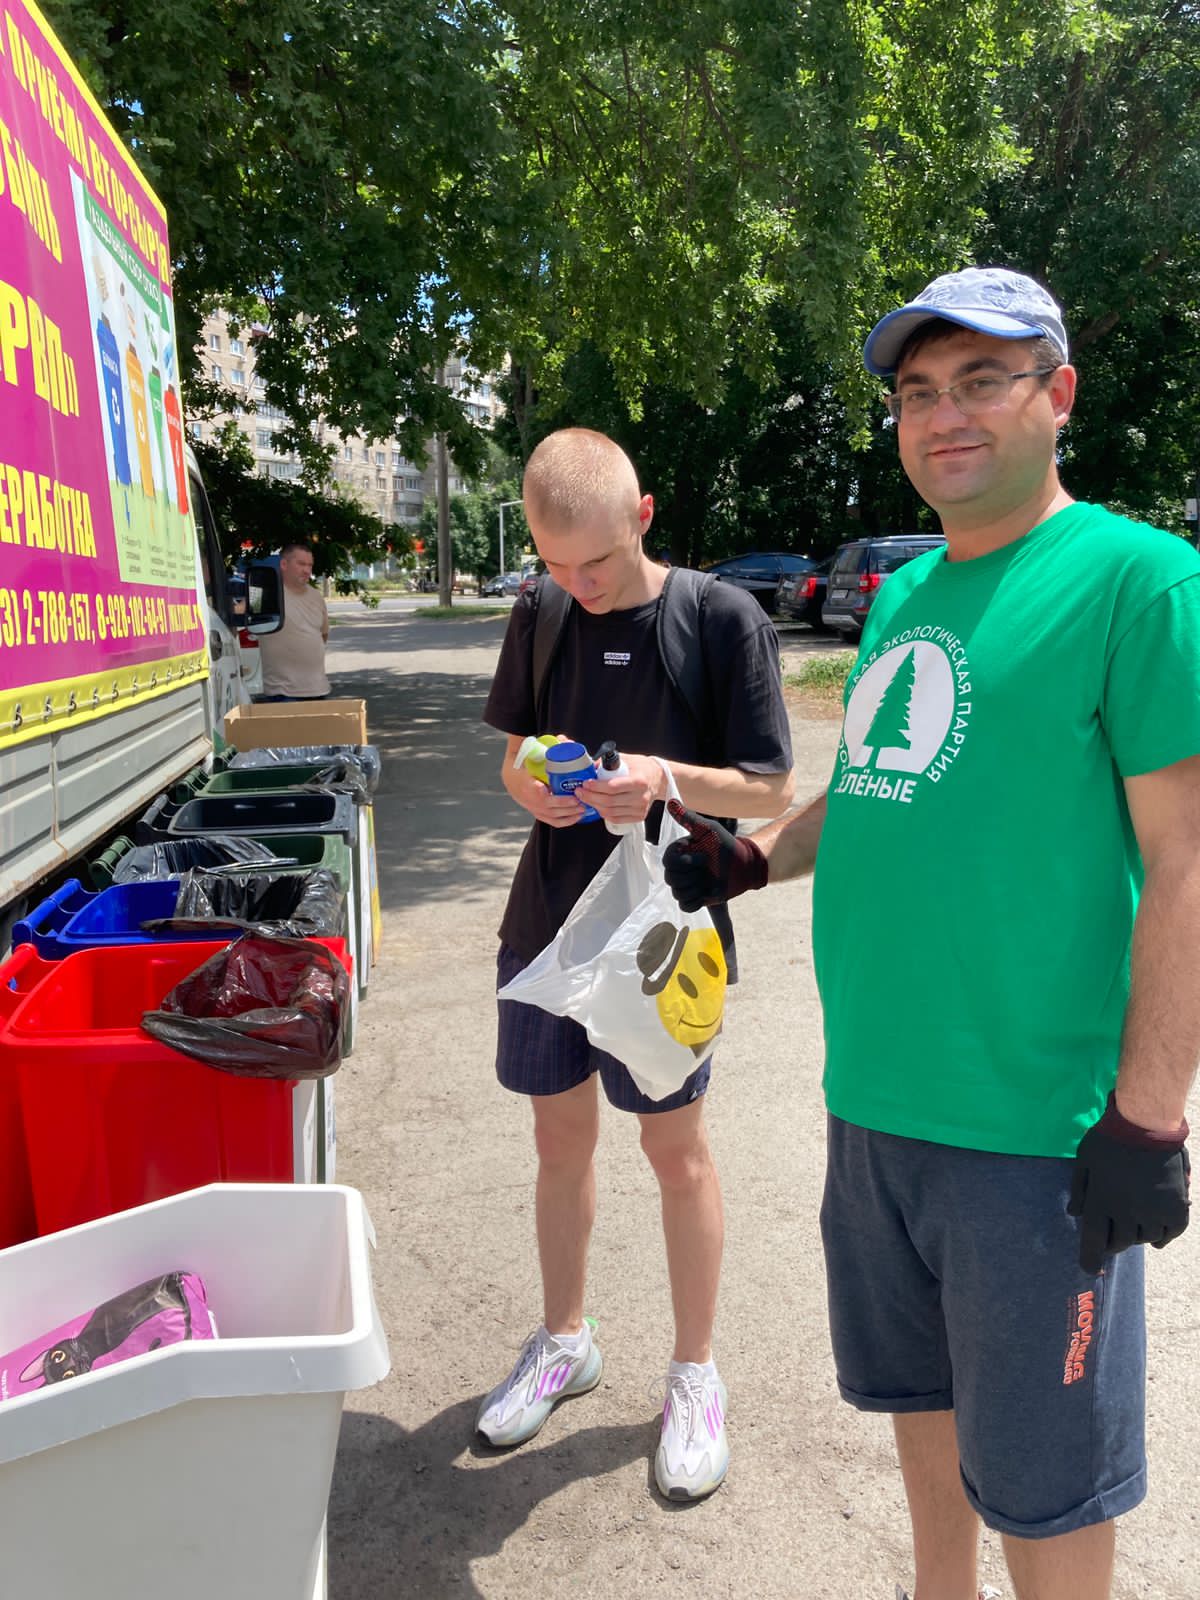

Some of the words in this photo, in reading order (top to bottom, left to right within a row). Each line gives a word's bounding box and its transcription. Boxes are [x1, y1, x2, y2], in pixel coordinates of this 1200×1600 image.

[0, 116, 63, 264] БИЛЬ
[0, 588, 21, 648] 3)
[881, 625, 972, 696] ЭКОЛОГИЧЕСКАЯ
[925, 702, 972, 783] ПАРТИЯ
[835, 769, 917, 803] ЛЁНЫЕ
[1073, 1291, 1094, 1380] MOVING
